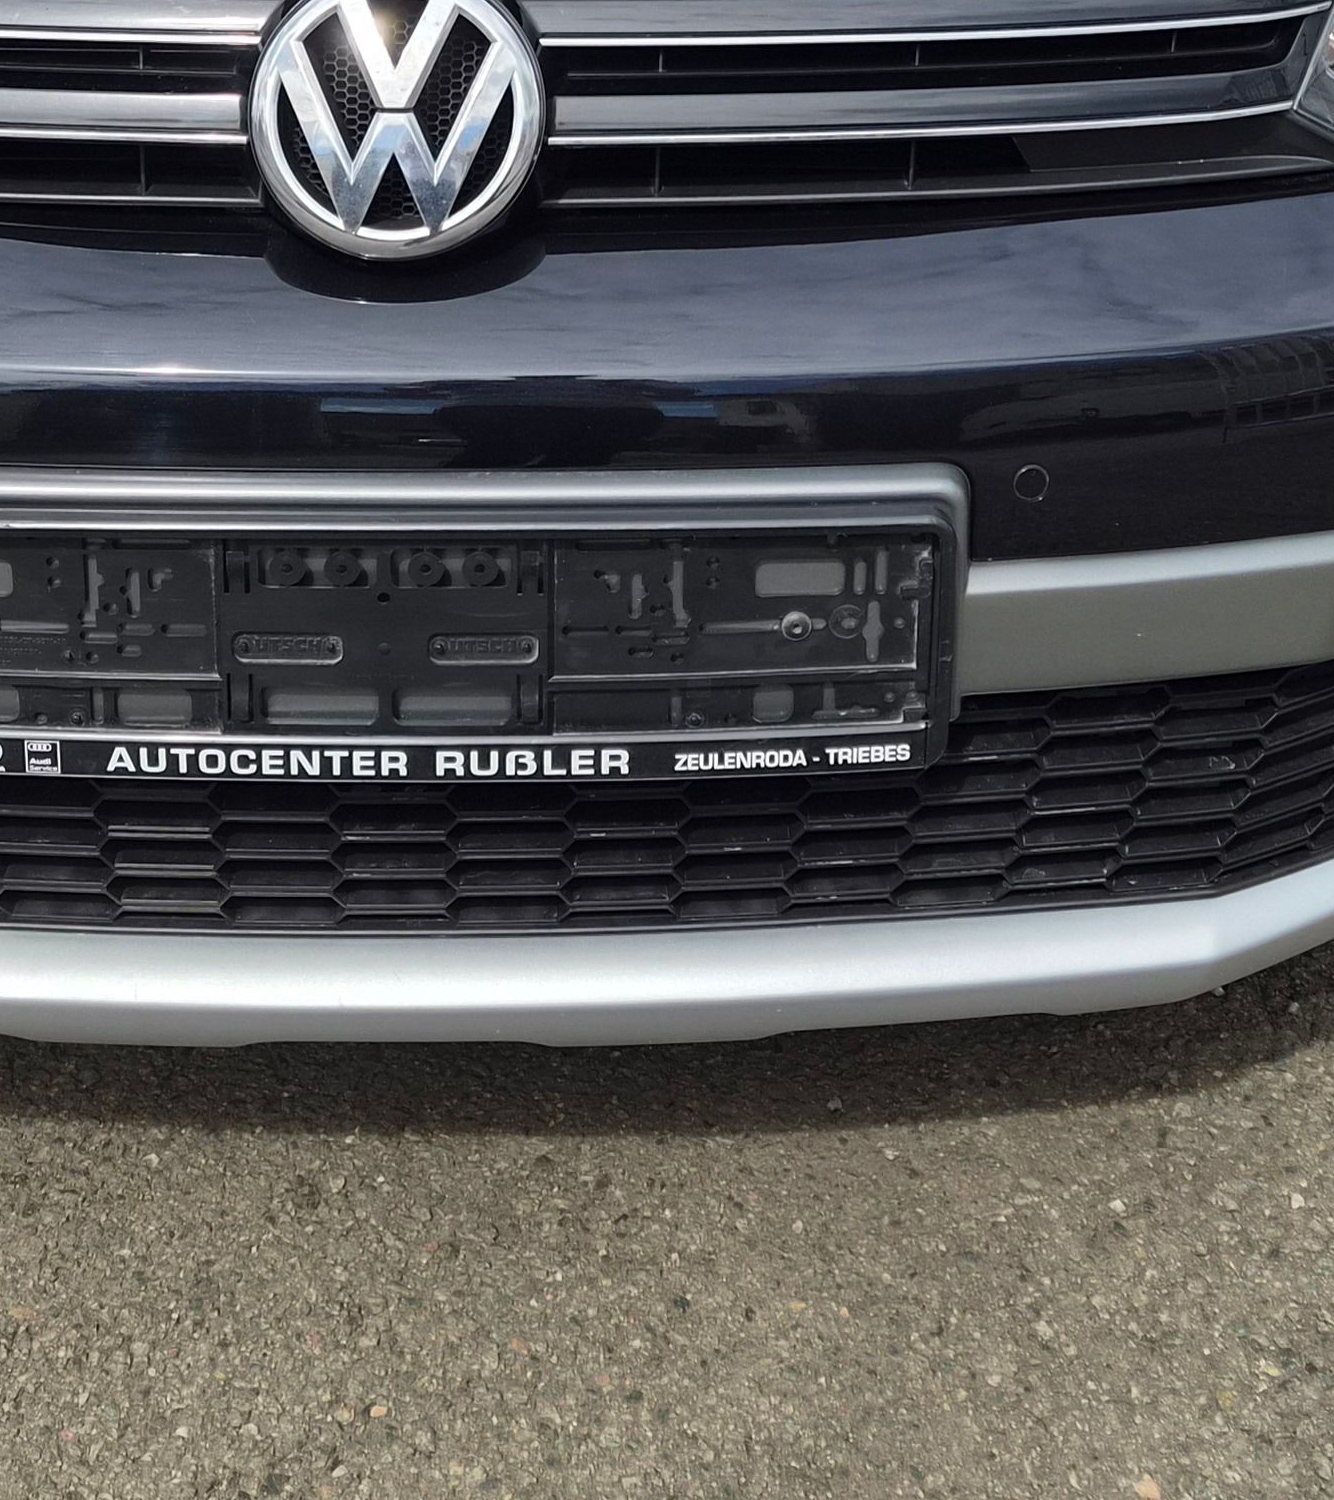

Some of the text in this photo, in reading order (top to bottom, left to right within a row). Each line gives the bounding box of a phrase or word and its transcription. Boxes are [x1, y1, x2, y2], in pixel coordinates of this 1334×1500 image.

[29, 757, 52, 765] Audi
[105, 746, 408, 777] AUTOCENTER
[434, 748, 631, 777] RUßLER
[674, 749, 808, 771] ZEULENRODA
[824, 743, 911, 765] TRIEBES
